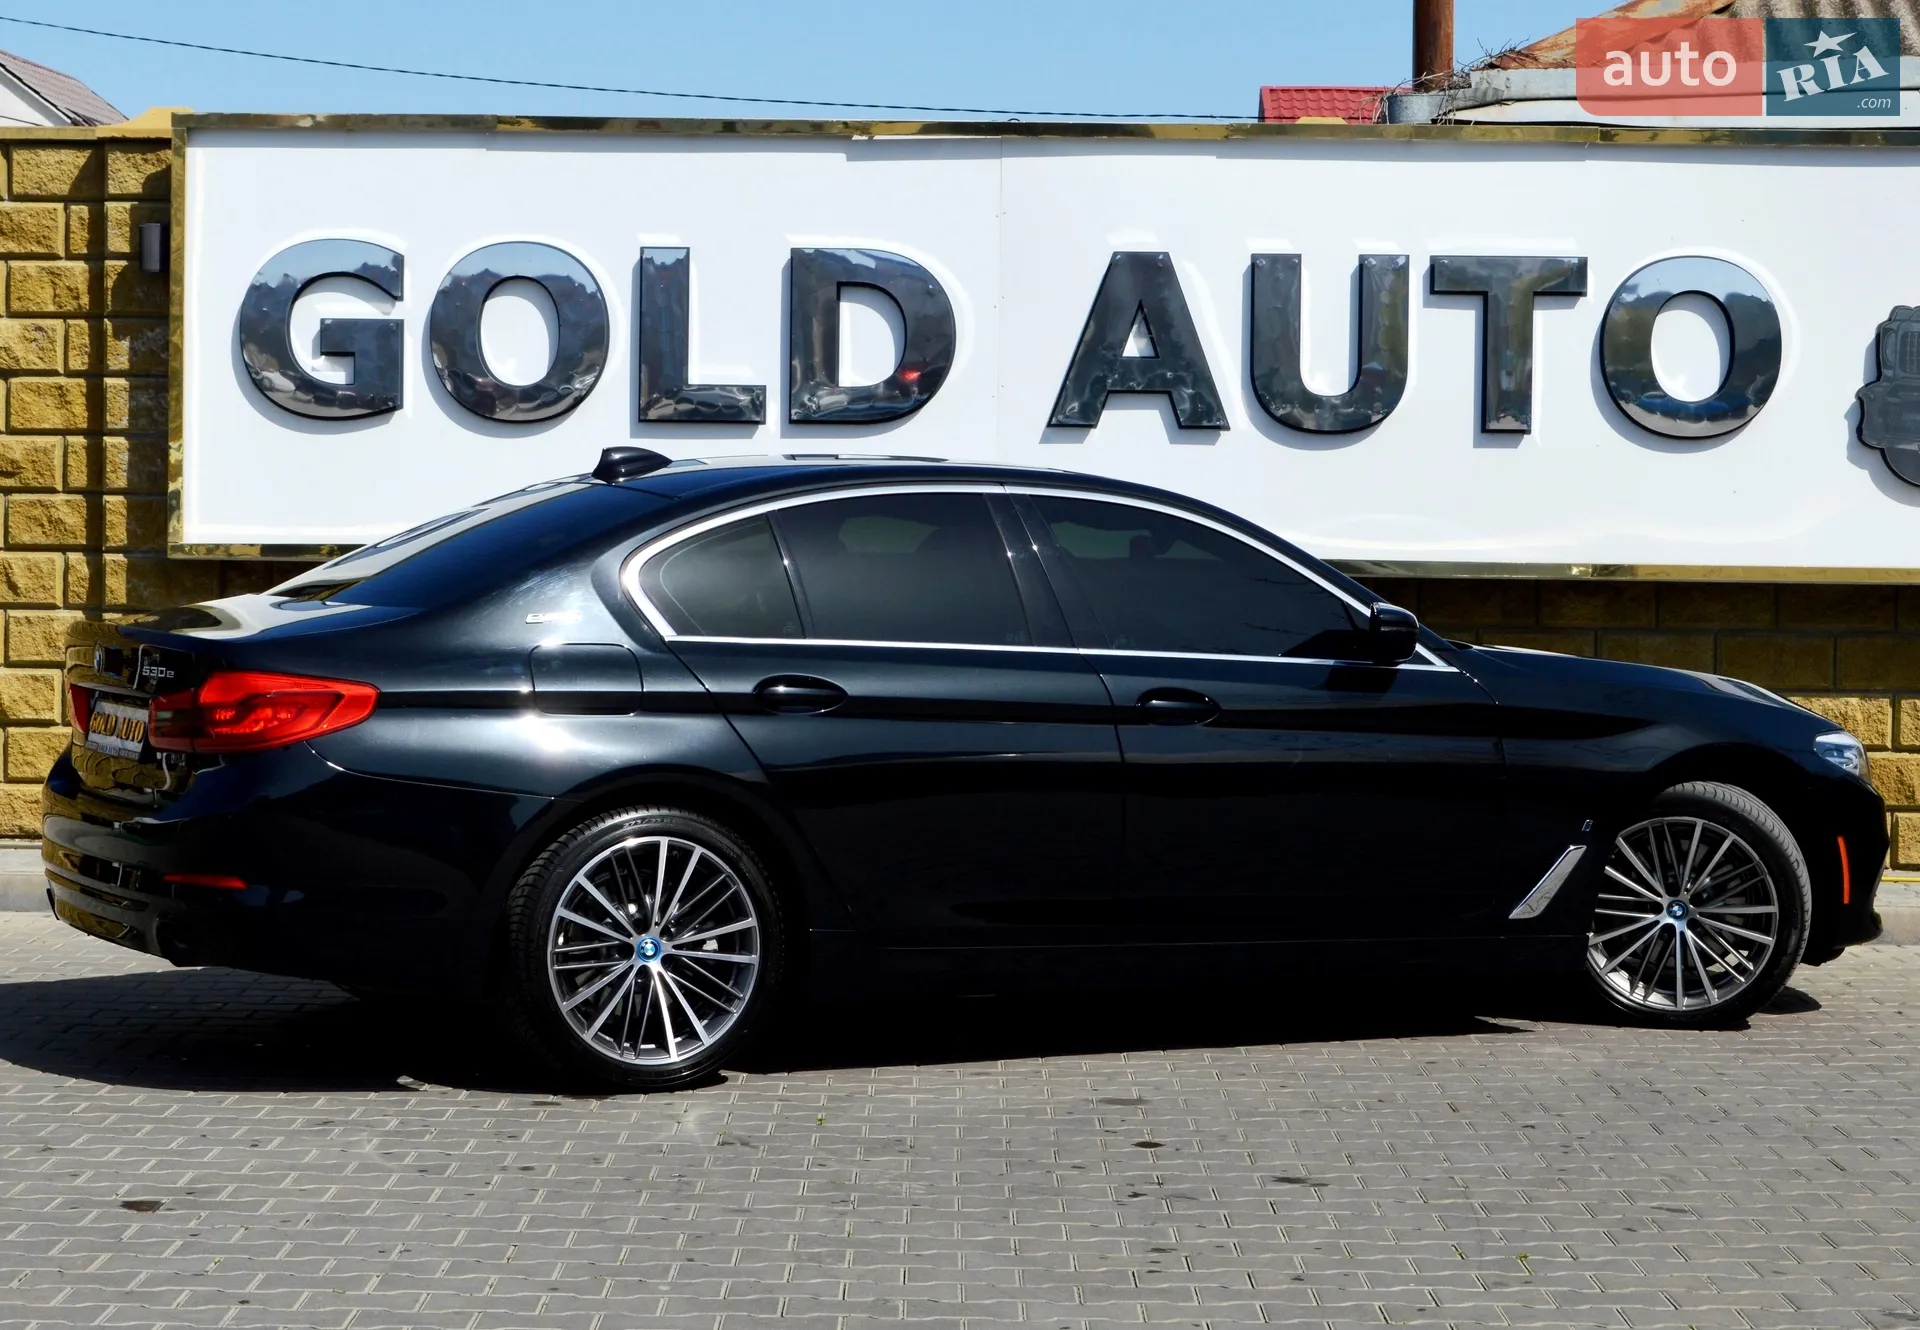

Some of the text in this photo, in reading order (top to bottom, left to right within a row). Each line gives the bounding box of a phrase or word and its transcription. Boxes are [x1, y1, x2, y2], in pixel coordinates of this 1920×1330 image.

[240, 238, 1782, 439] GOLD AUTO
[142, 666, 175, 678] 530e
[90, 711, 146, 743] GOLD AUTO
